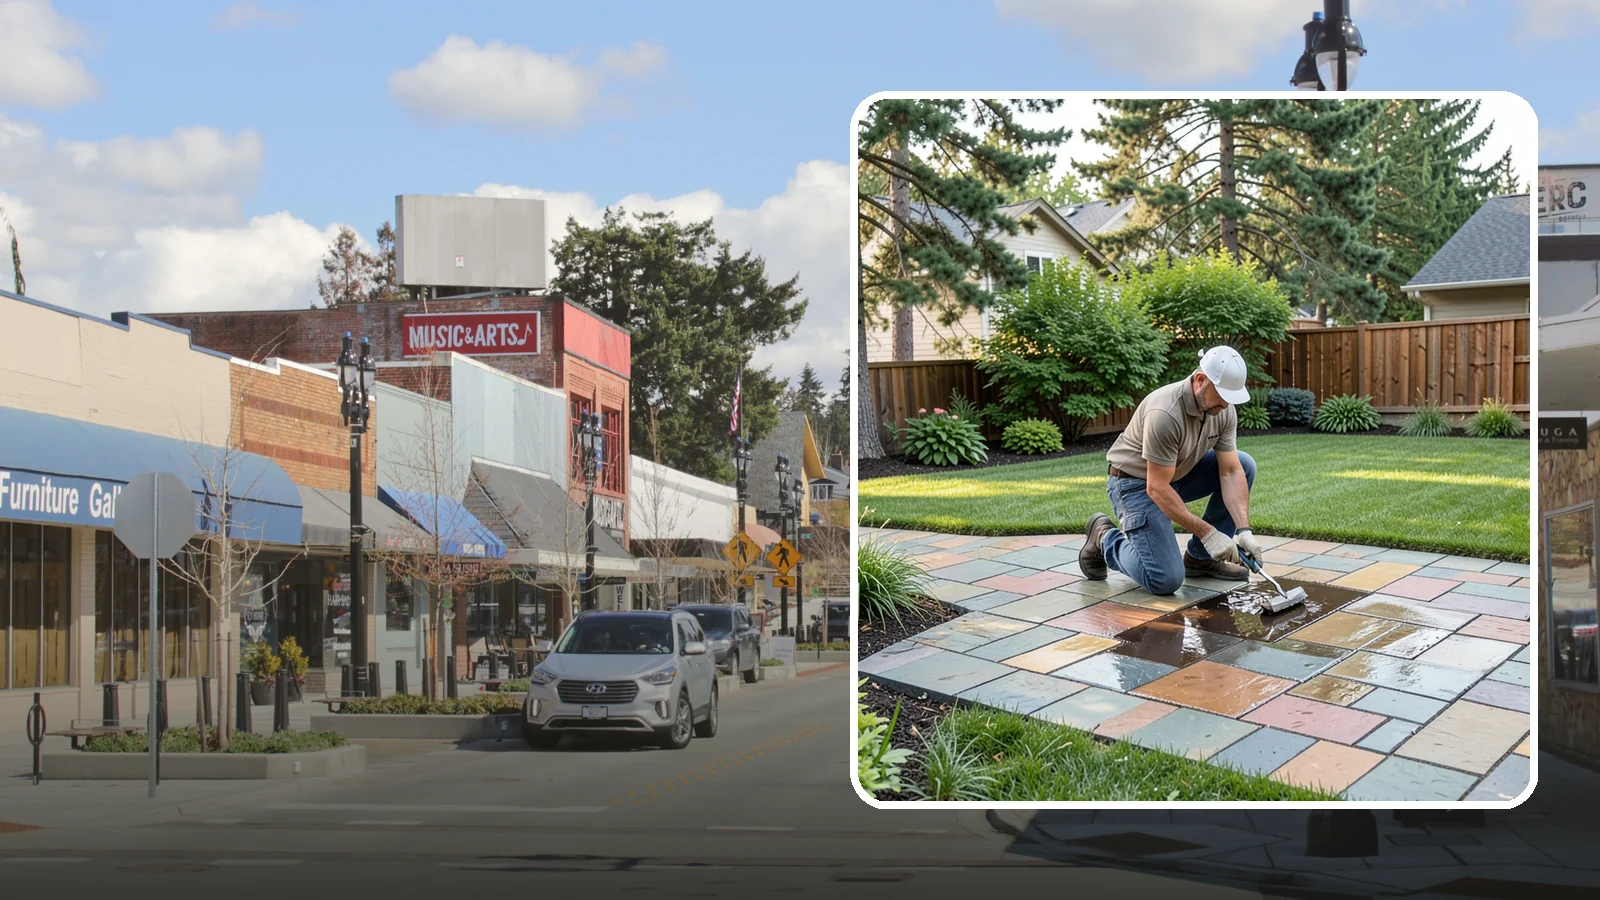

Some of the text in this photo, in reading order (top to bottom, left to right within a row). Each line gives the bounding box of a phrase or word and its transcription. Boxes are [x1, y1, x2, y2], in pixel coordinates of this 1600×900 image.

[409, 323, 520, 348] MUSIC&ARTS
[0, 471, 122, 519] Furniture Gal
